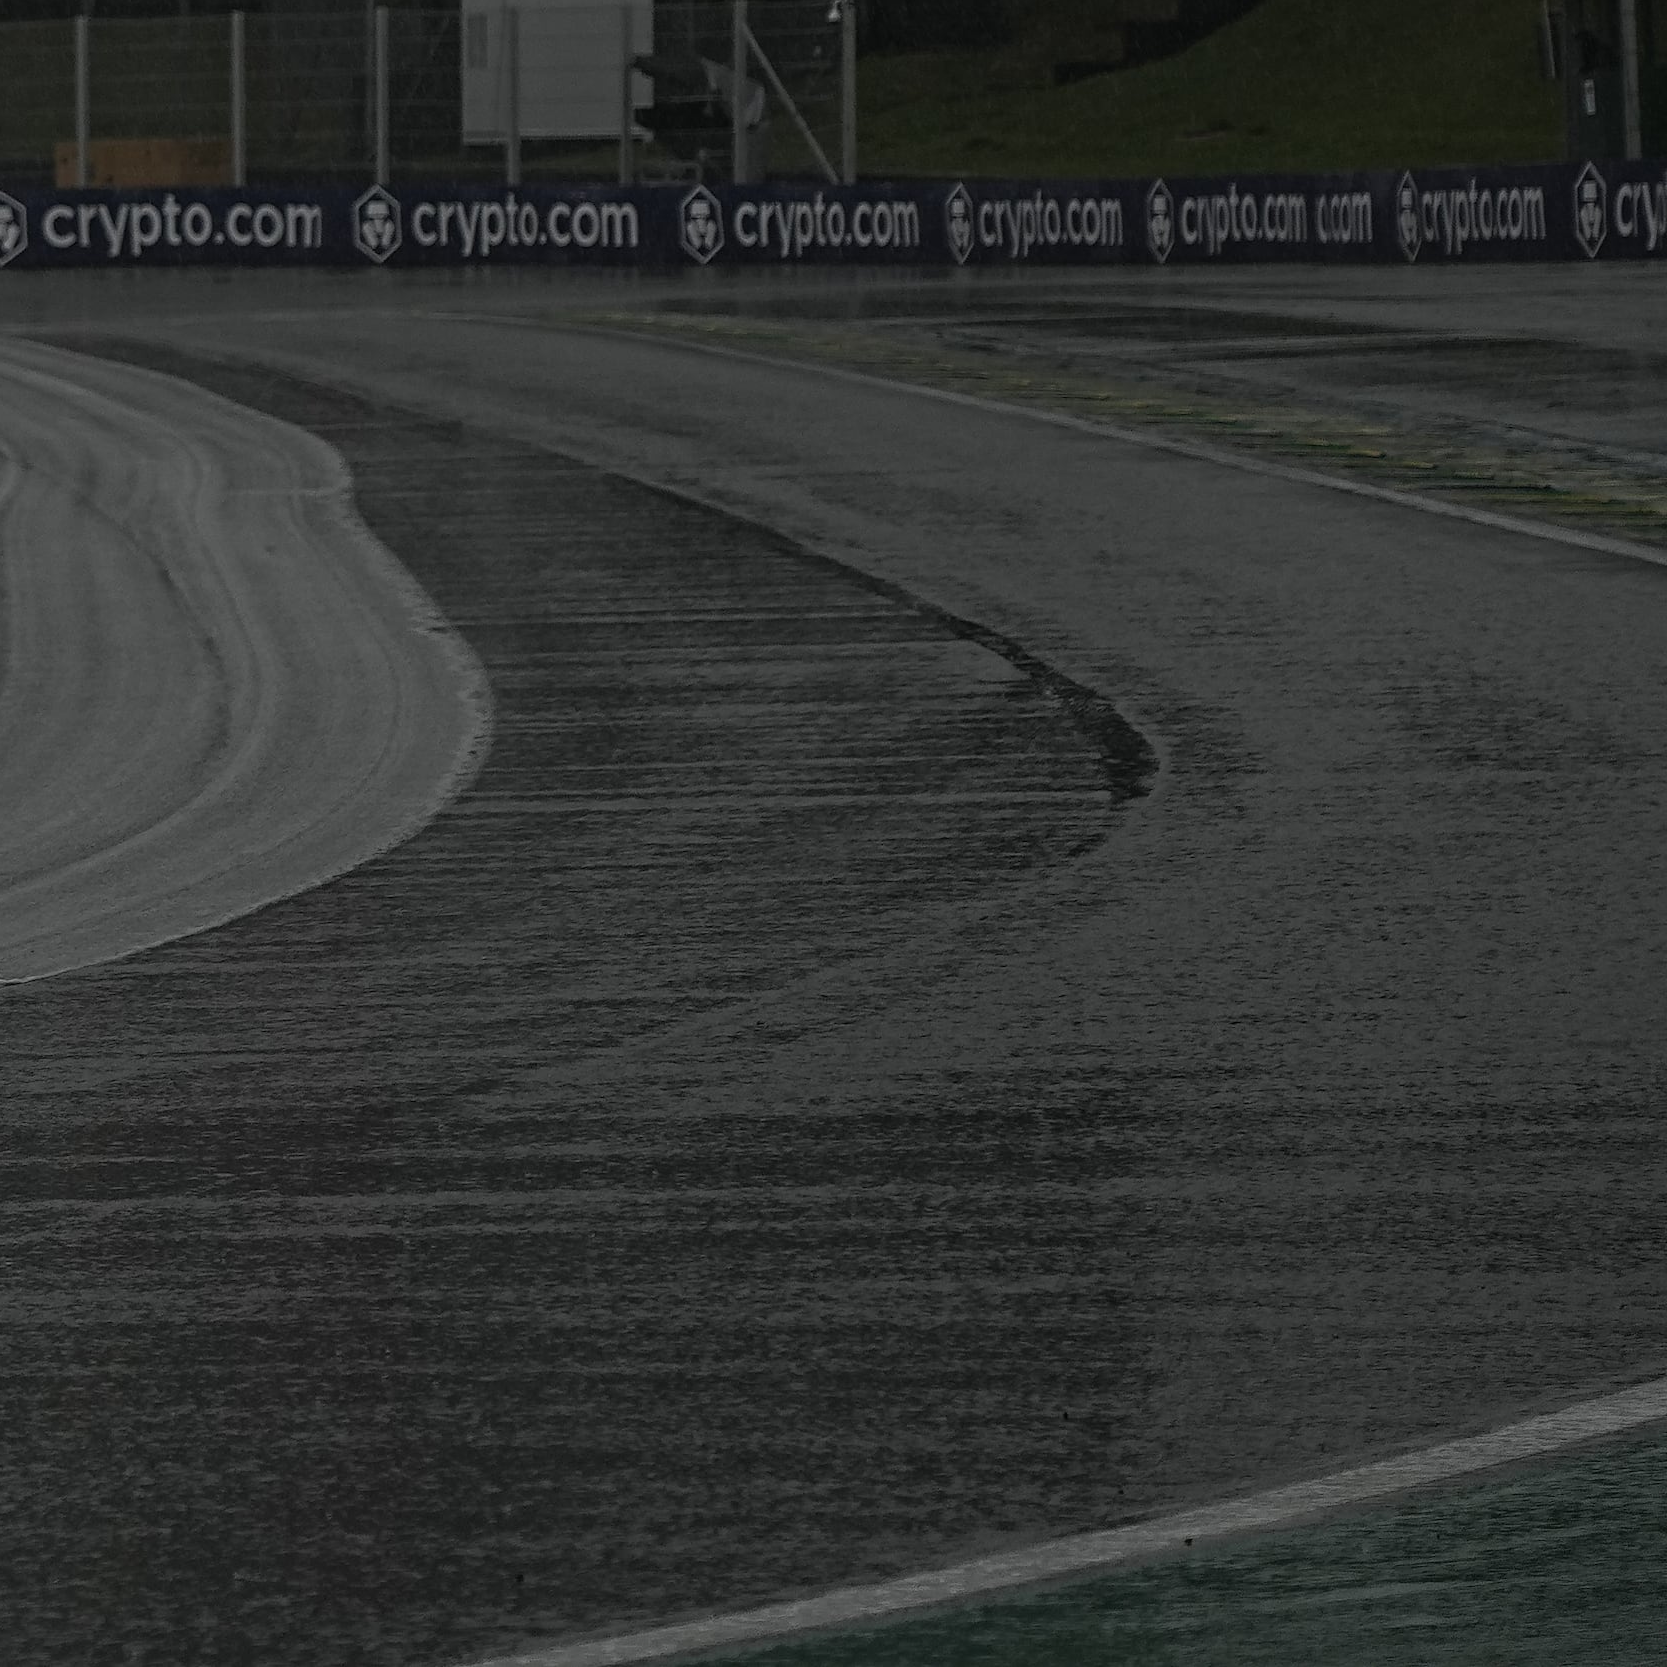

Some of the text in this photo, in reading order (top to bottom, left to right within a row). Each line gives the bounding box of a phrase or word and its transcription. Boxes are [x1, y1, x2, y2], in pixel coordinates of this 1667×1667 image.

[41, 191, 323, 258] crypto.com
[410, 191, 640, 257] crypto.com
[733, 191, 921, 258] crypto.com
[979, 188, 1124, 259] crypto.com
[1181, 182, 1308, 256] crypto.com
[1422, 176, 1546, 256] crypto.com
